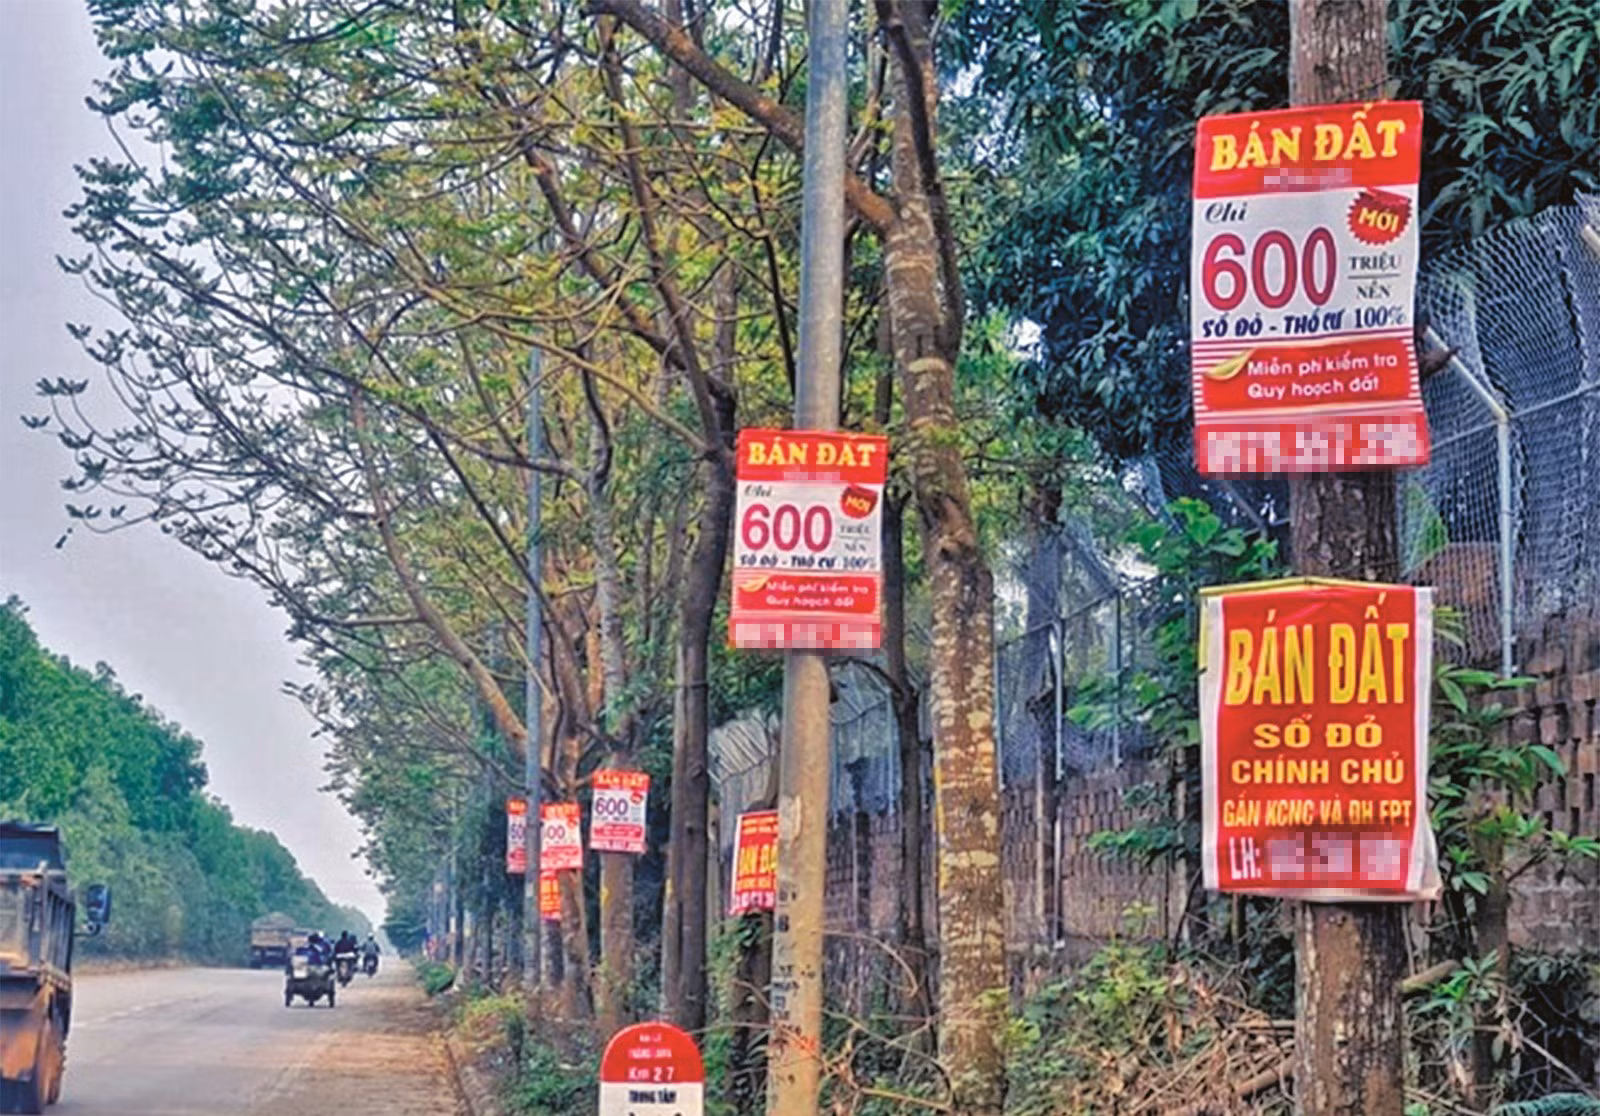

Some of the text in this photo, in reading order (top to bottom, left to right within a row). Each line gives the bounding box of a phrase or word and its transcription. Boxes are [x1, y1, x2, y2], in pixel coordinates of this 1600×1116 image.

[1209, 103, 1406, 171] BÁN ĐẤT
[1358, 207, 1400, 233] MỚI
[1202, 227, 1337, 311] 600
[1235, 312, 1263, 337] ĐỎ
[1354, 306, 1407, 328] 100%
[1373, 353, 1398, 368] tra
[1247, 382, 1287, 400] Quy
[1348, 371, 1379, 393] đất
[748, 436, 808, 466] BÁN
[742, 503, 832, 552] 600
[1225, 591, 1410, 705] BÁN ĐẤT
[1253, 713, 1382, 748] SỔ ĐỎ
[1231, 751, 1405, 784] CHÍNH CHỦ
[595, 797, 629, 815] 600
[1264, 799, 1315, 828] KCNC
[1379, 799, 1412, 828] FPT
[1229, 836, 1263, 881] LH:
[629, 1066, 650, 1080] Km
